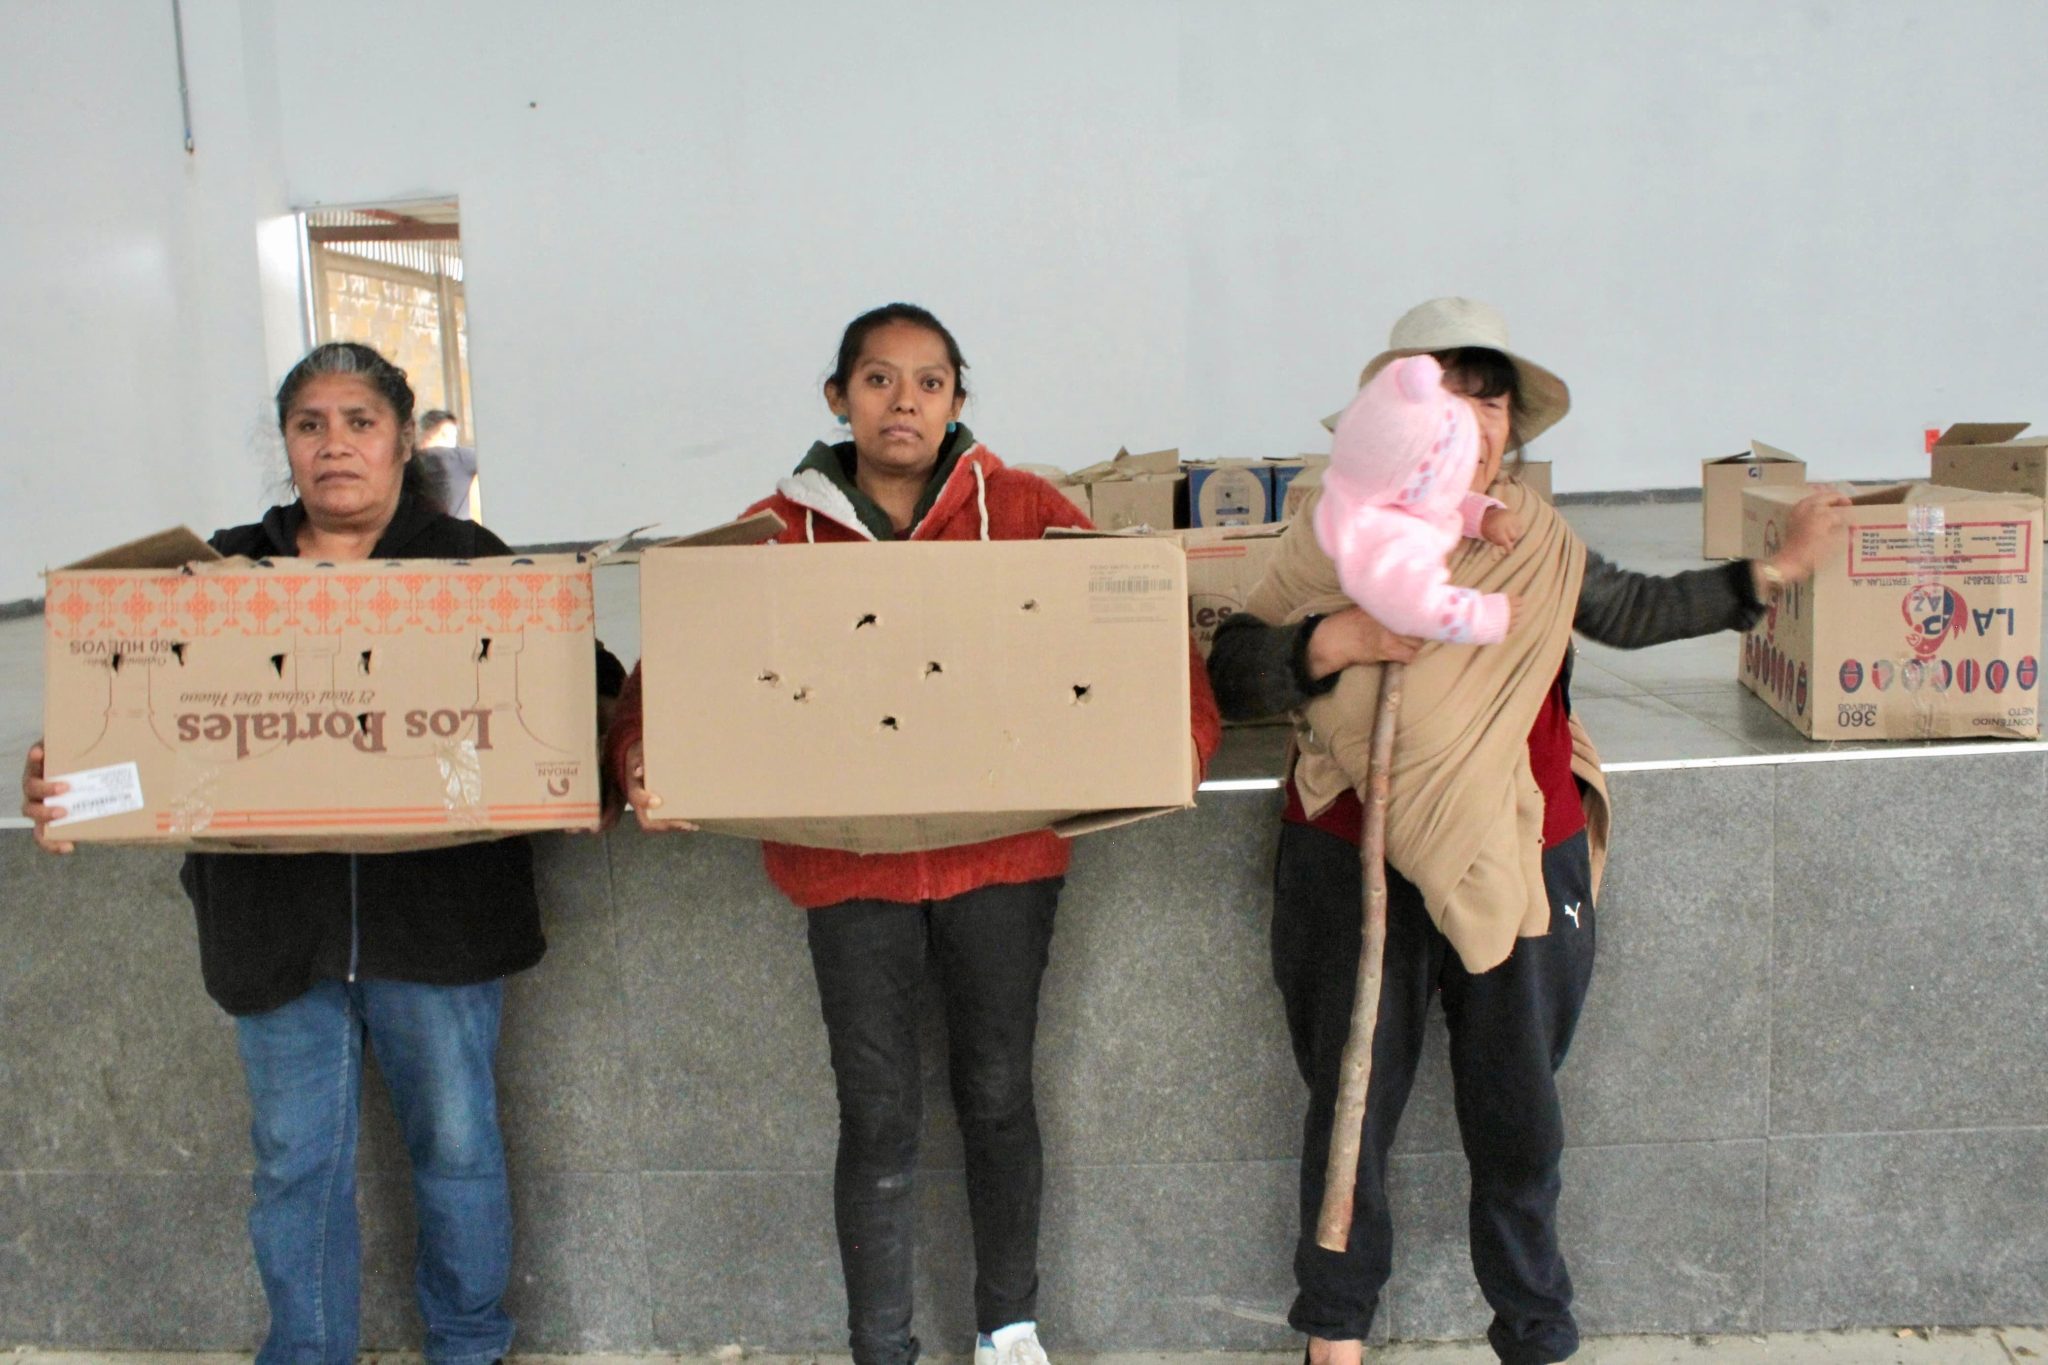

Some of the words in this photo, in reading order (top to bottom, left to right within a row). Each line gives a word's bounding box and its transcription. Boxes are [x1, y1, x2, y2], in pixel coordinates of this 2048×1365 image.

[1971, 607, 2015, 637] LA
[69, 640, 144, 655] HUEVOS
[233, 692, 263, 706] Del
[268, 691, 316, 705] Sabor
[319, 690, 356, 705] Real
[358, 690, 376, 704] El
[1838, 703, 1877, 712] HUEVOS
[2008, 708, 2035, 717] NETO
[1837, 710, 1877, 728] 360
[1972, 716, 2035, 727] CONTENIDO
[176, 709, 387, 760] Portales
[404, 708, 494, 751] Los
[537, 767, 579, 777] PROAN
